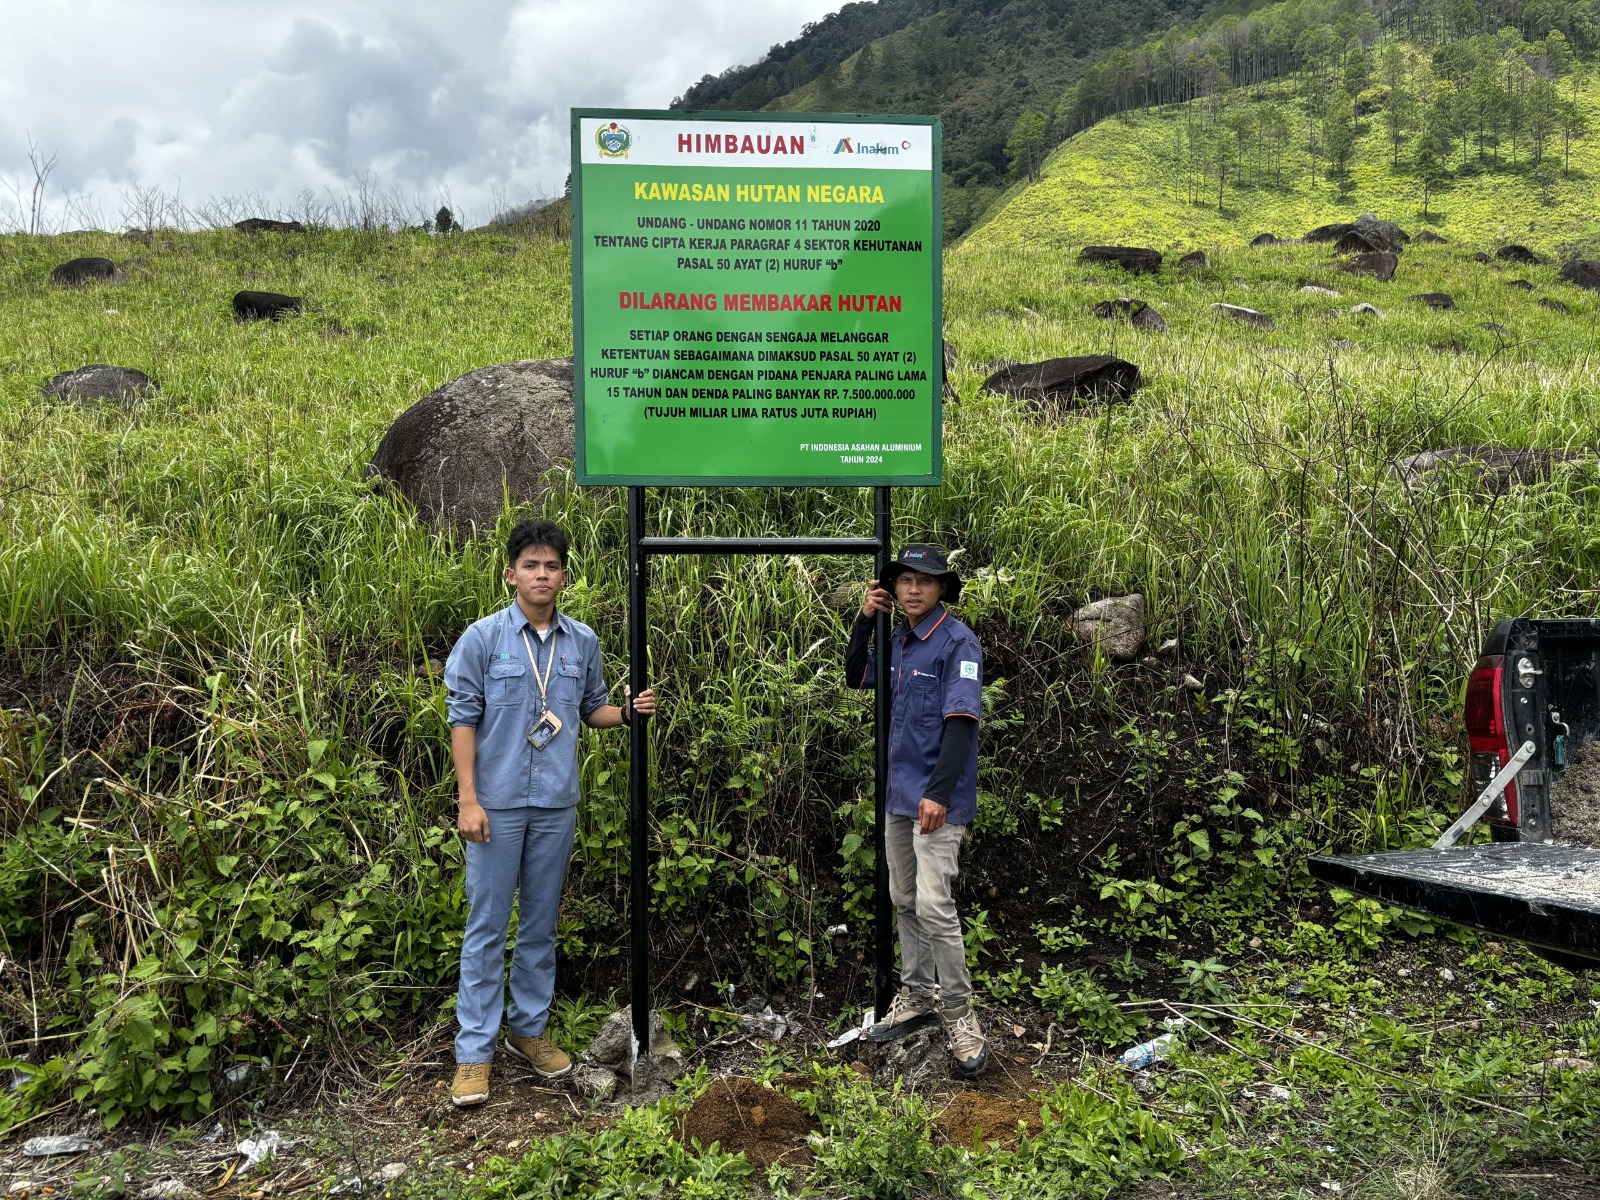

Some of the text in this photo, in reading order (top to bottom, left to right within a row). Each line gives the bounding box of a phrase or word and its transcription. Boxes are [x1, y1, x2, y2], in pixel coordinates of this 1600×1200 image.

[678, 134, 804, 154] HIMBAUAN
[857, 142, 899, 155] Inalum
[635, 182, 884, 203] KAWASAN HUTAN NEGARA
[638, 217, 686, 229] UNDANG
[697, 219, 745, 230] UNDANG
[750, 219, 791, 230] NOMOR
[796, 219, 806, 230] 11
[811, 220, 850, 231] TAHUN
[854, 219, 880, 231] 2020
[594, 236, 921, 252] TENTANG CIPTA KERJA PARAGRAF 4 SEKTOR KEHUTANAN
[678, 258, 713, 269] PASAL
[717, 259, 730, 270] 50
[734, 259, 762, 270] AYAT
[766, 259, 779, 273] (2)
[784, 259, 822, 270] HURUF
[620, 291, 902, 312] DILARANG MEMBAKAR HUTAN
[630, 330, 889, 343] SETIAP ORANG DENGAN SENGAJA MELANGGAR
[602, 349, 916, 364] KETENTUAN SEBAGAIMANA DIMAKSUD PASAL 50 AYAT (2)
[591, 368, 629, 378] HURUF
[651, 368, 704, 379] DIANCAM
[708, 369, 755, 380] DENGAN
[758, 369, 798, 380] PIDANA
[802, 370, 851, 380] PENJARA
[855, 370, 894, 381] PALING
[898, 371, 927, 381] LAMA
[607, 387, 915, 399] 15 TAHUN DAN DENDA PALING BANYAK RP. 7.500.000.000
[644, 407, 876, 421] (TUJUH MILIAR LIMA RATUS JUTA RUPIAH)
